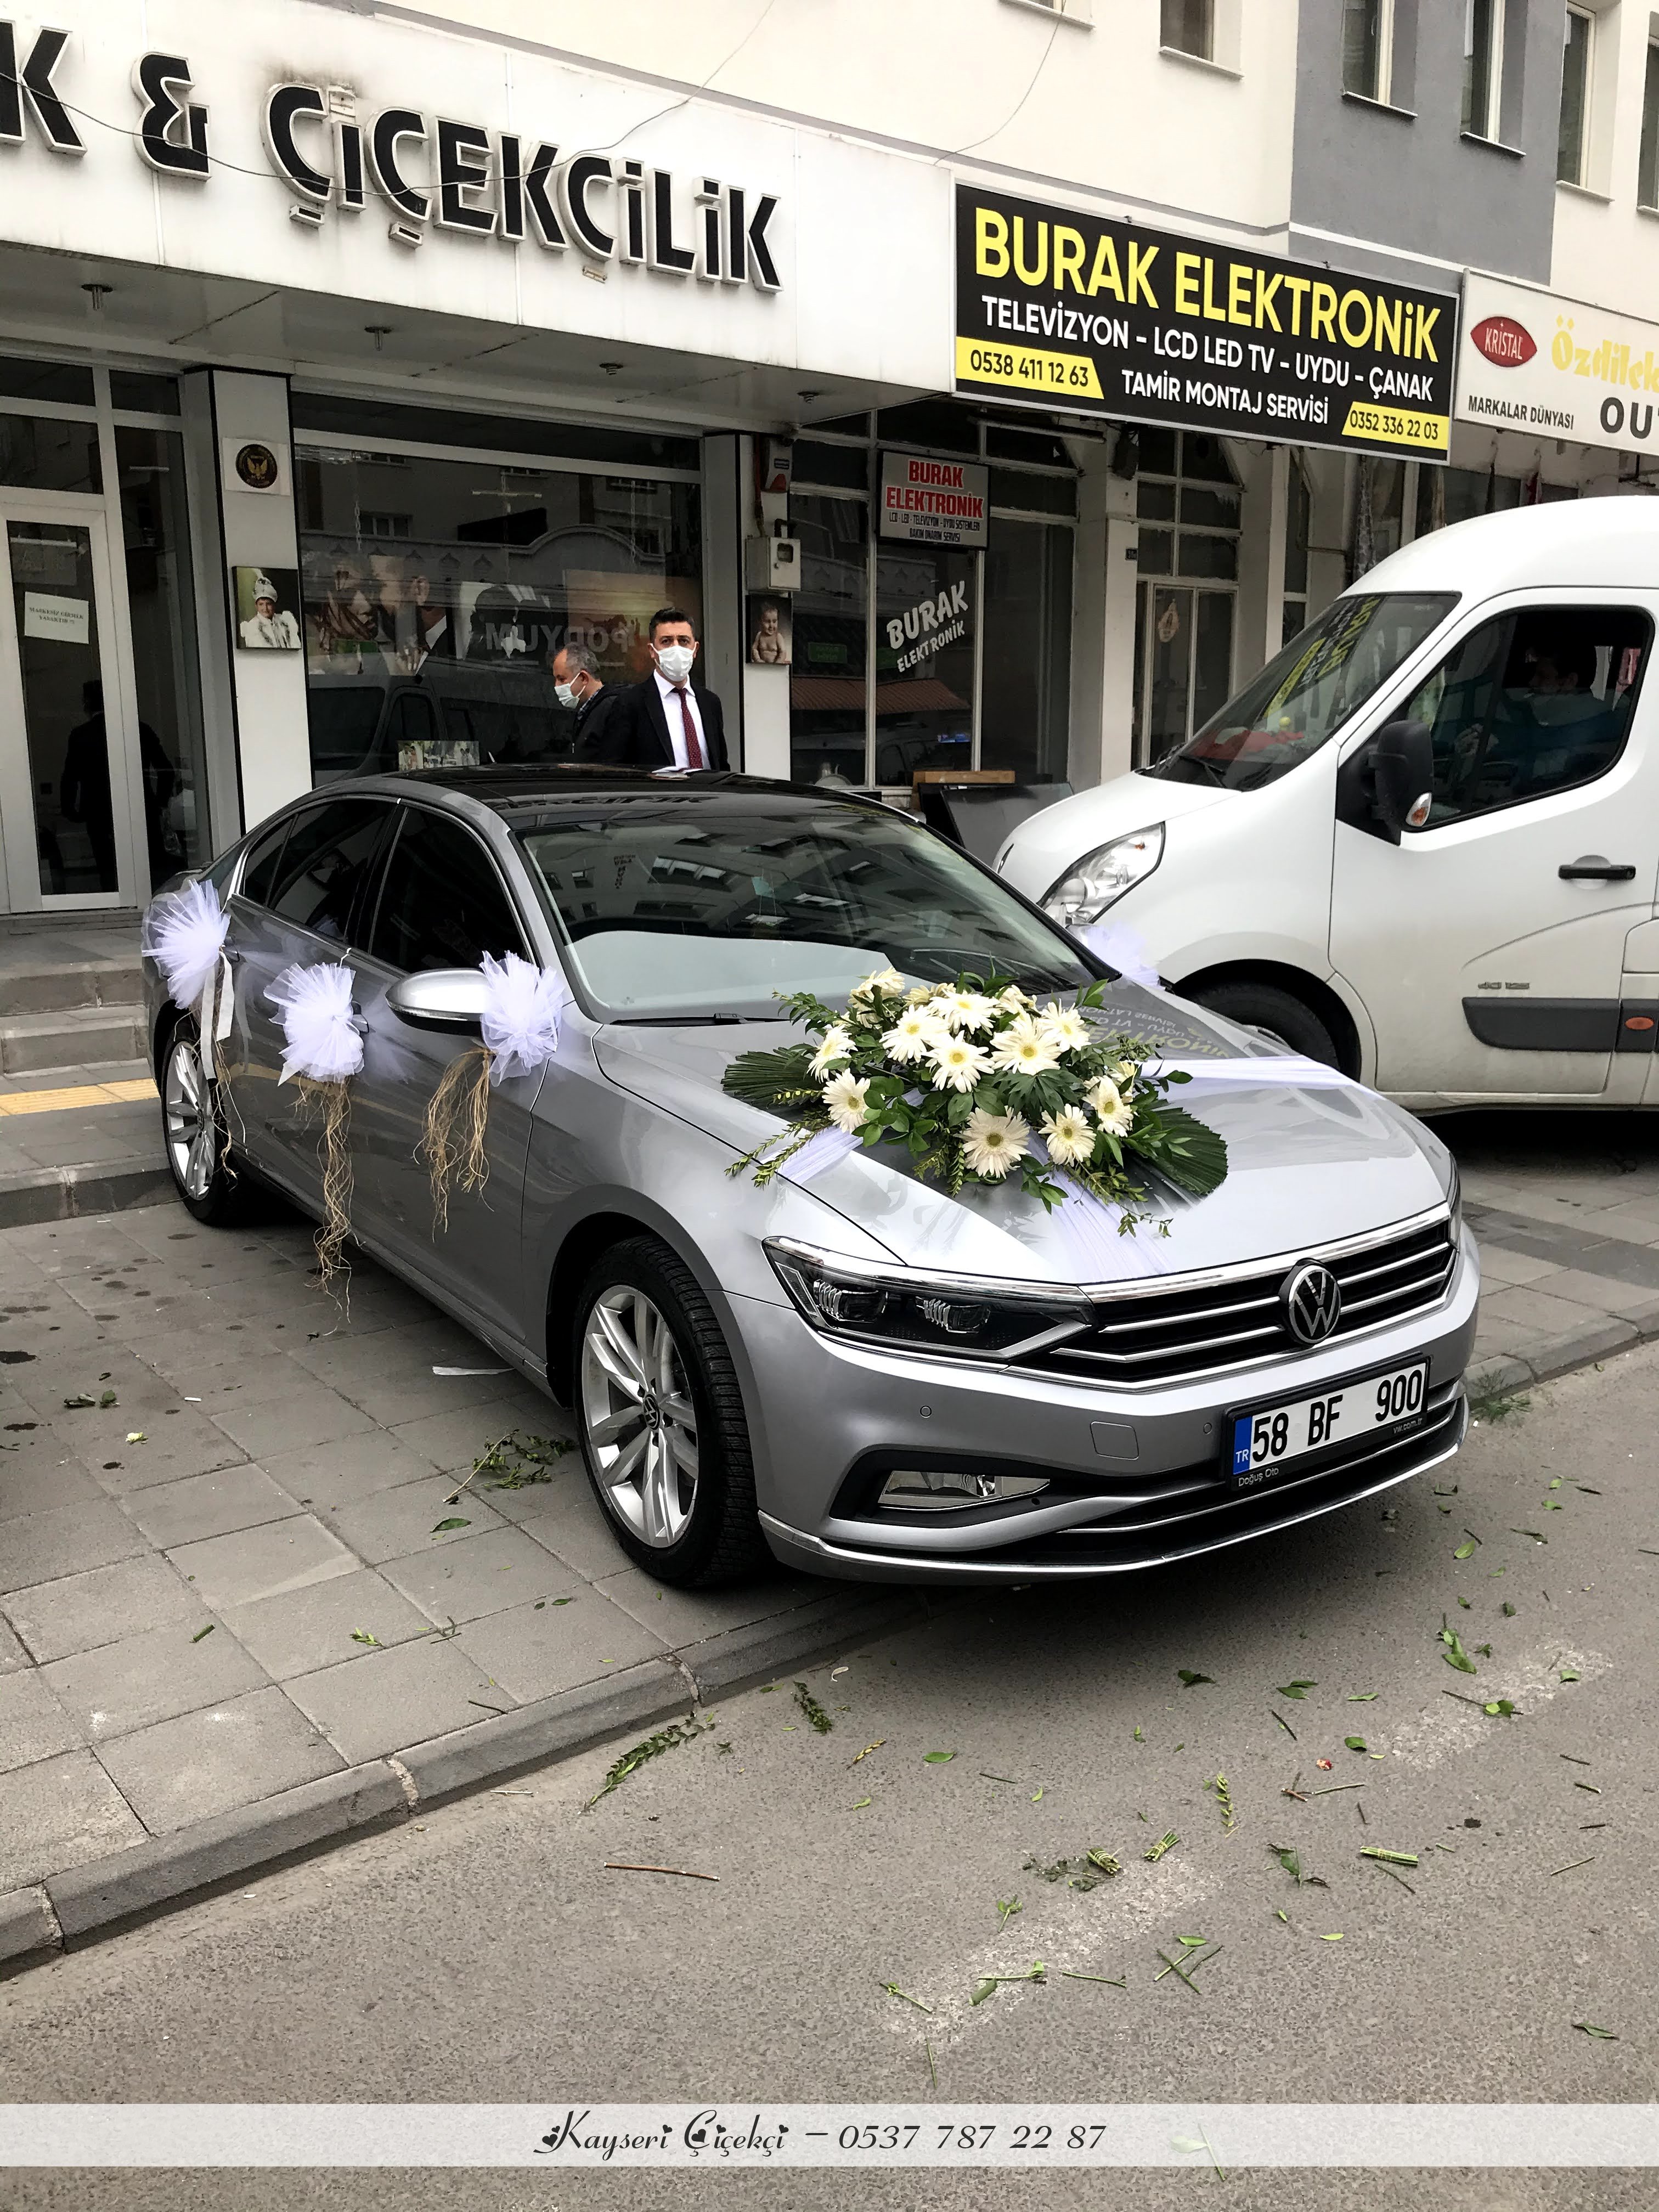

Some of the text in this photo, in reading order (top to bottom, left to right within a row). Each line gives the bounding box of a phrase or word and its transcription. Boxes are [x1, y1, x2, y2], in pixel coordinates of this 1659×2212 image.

[131, 52, 211, 181] &
[975, 207, 1160, 309] BURAK
[970, 349, 1088, 387] 0538 411 12 63
[981, 295, 1128, 349] TELEVİZYON
[1154, 326, 1198, 360] LCD
[1204, 335, 1243, 368] LED
[1248, 344, 1275, 374] TV
[1296, 353, 1350, 387] UYDU
[1369, 367, 1433, 402] ÇANAK
[1121, 369, 1329, 424] TAMİR MONTAJ SERVİSİ
[1469, 396, 1574, 430] MARKALAR DÜNYASI
[1350, 410, 1438, 440] 0352 336 22 03
[1600, 397, 1659, 439] OU
[909, 460, 964, 488] BURAK
[886, 486, 983, 518] ELEKTRONİK
[887, 580, 968, 650] BURAK
[1252, 1369, 1423, 1462] 58 BF 900
[1235, 1449, 1249, 1463] TR
[1238, 1468, 1279, 1487] Doğuş Oto
